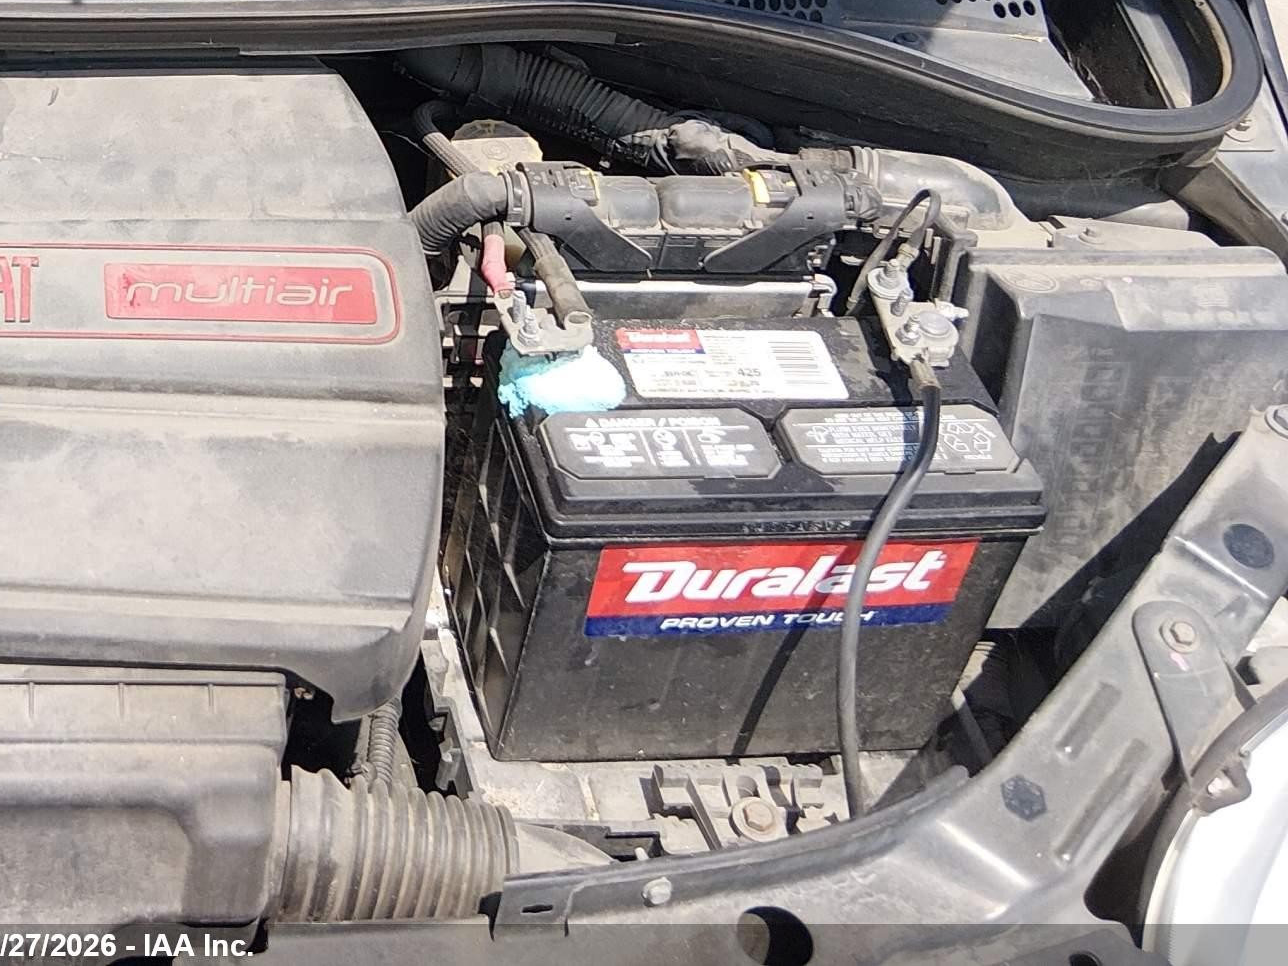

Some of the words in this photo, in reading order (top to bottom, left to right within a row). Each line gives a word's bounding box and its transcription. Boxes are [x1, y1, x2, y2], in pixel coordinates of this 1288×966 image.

[126, 276, 353, 309] multiair
[737, 367, 762, 377] 425
[622, 550, 945, 604] Duralast
[660, 614, 776, 630] PROVEN
